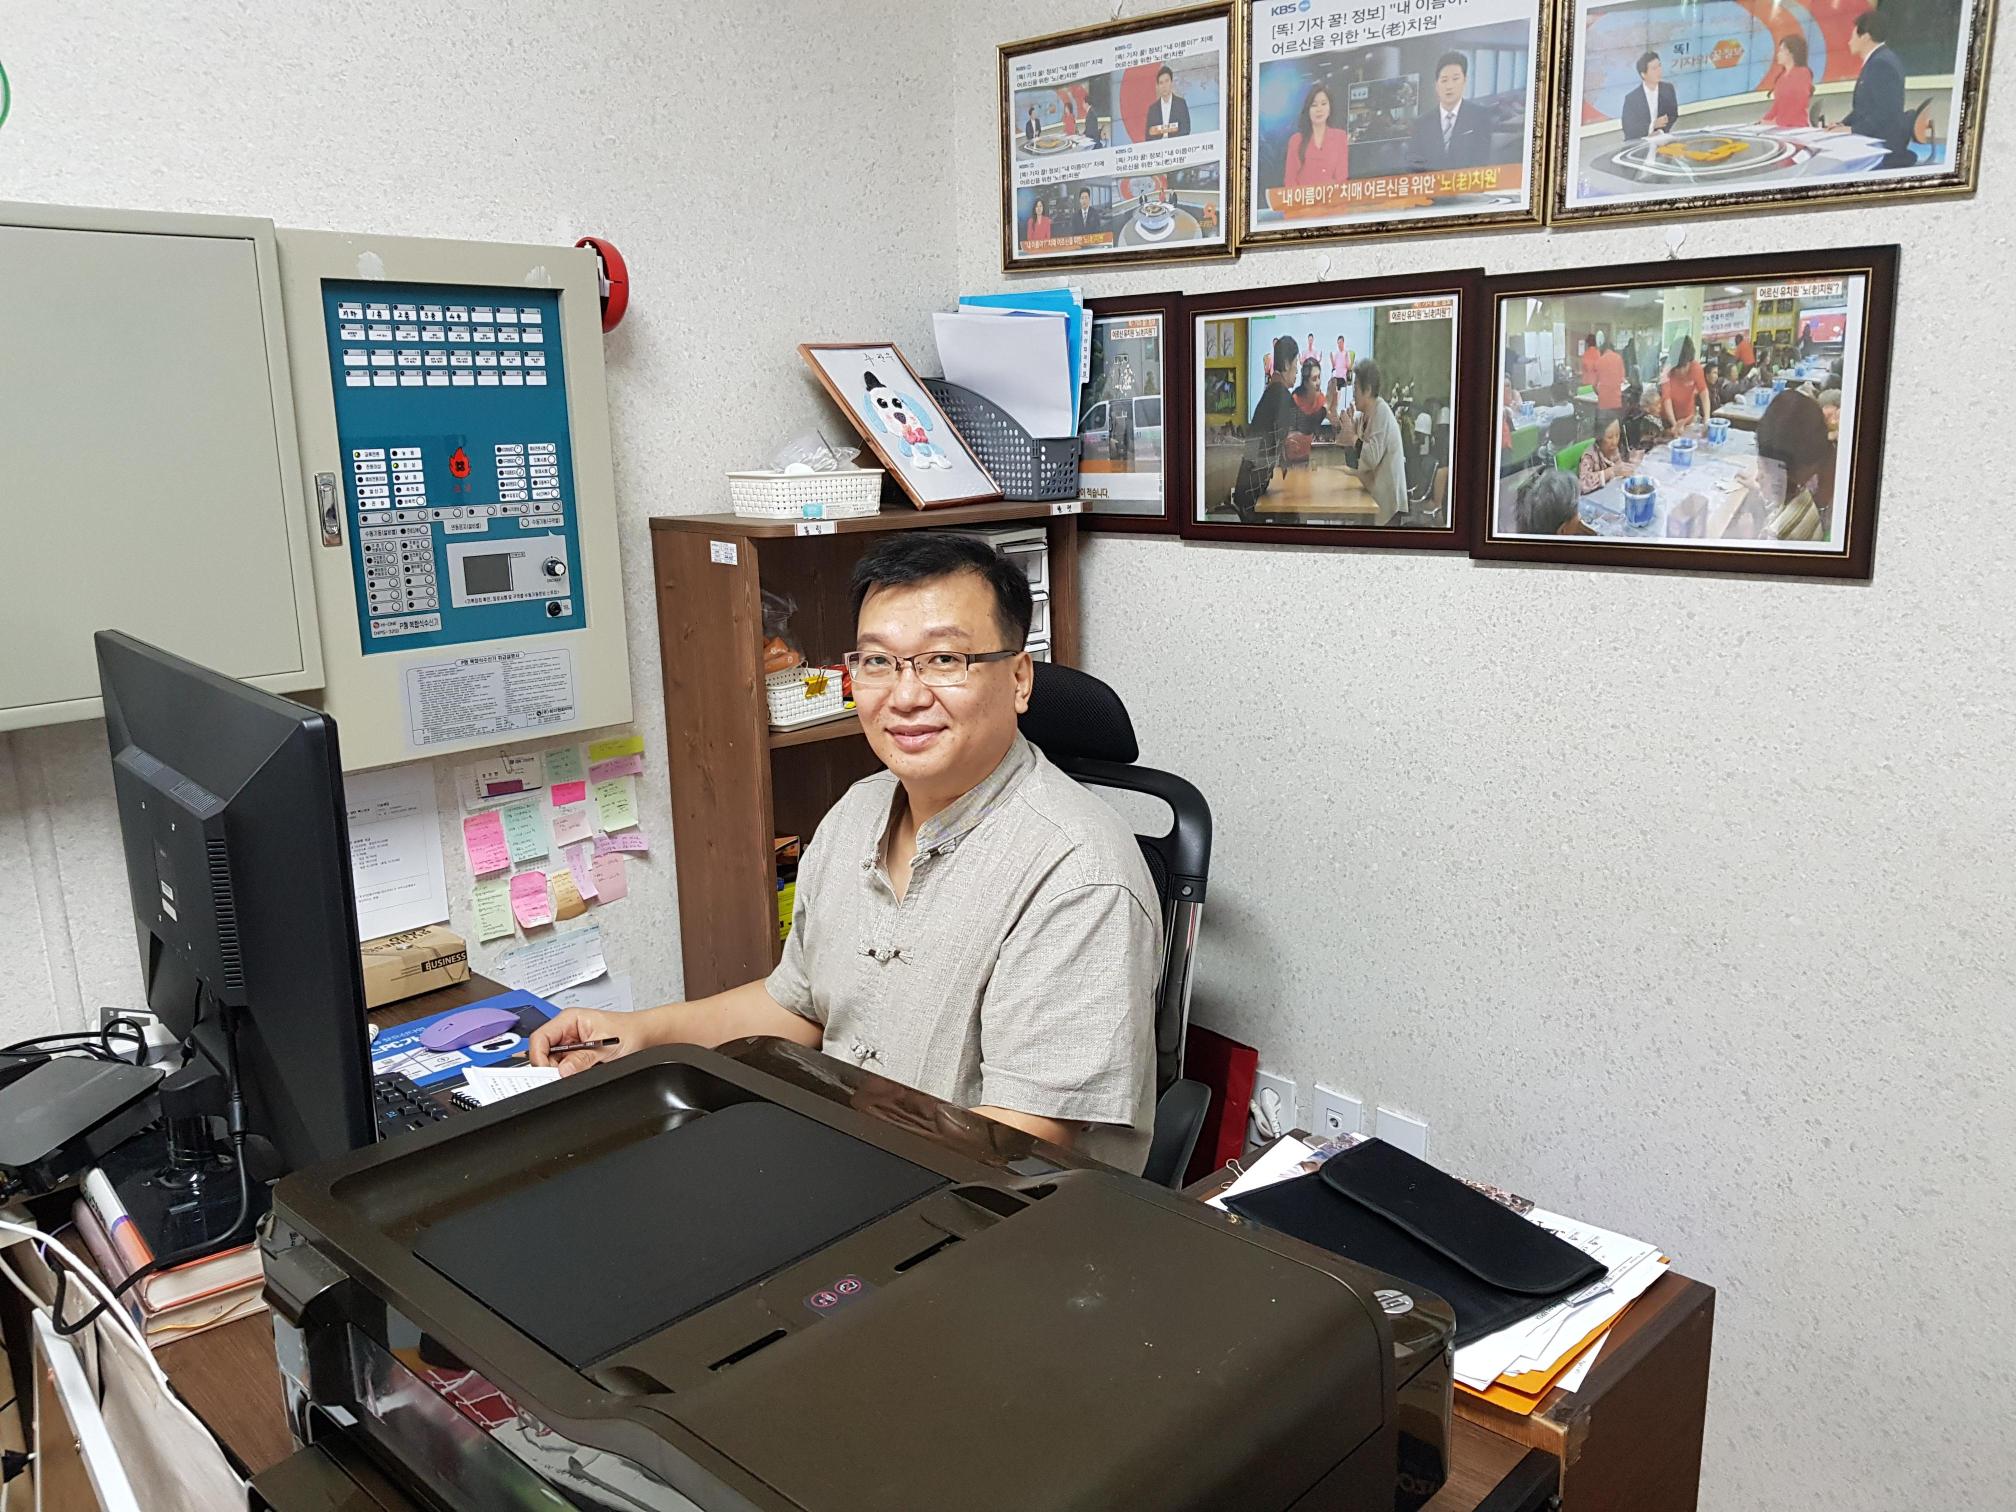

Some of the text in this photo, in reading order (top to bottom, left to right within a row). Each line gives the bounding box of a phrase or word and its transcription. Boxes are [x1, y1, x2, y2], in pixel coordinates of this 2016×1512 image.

[1271, 3, 1297, 16] KBS
[1272, 23, 1294, 40] [똑!
[1298, 15, 1325, 32] 기자
[1327, 12, 1347, 28] 꿀!
[1351, 5, 1385, 24] 정보]
[1390, 0, 1411, 14] "내
[1272, 34, 1326, 55] 어르신을
[1330, 29, 1360, 46] 위한
[1340, 183, 1362, 201] 치매
[1364, 177, 1409, 199] 어르신을
[1411, 174, 1436, 194] 위한
[1759, 287, 1779, 298] 어르신
[1780, 286, 1800, 297] 유치원
[1086, 487, 1110, 499] 적습니다.
[425, 951, 467, 971] BUSINESS
